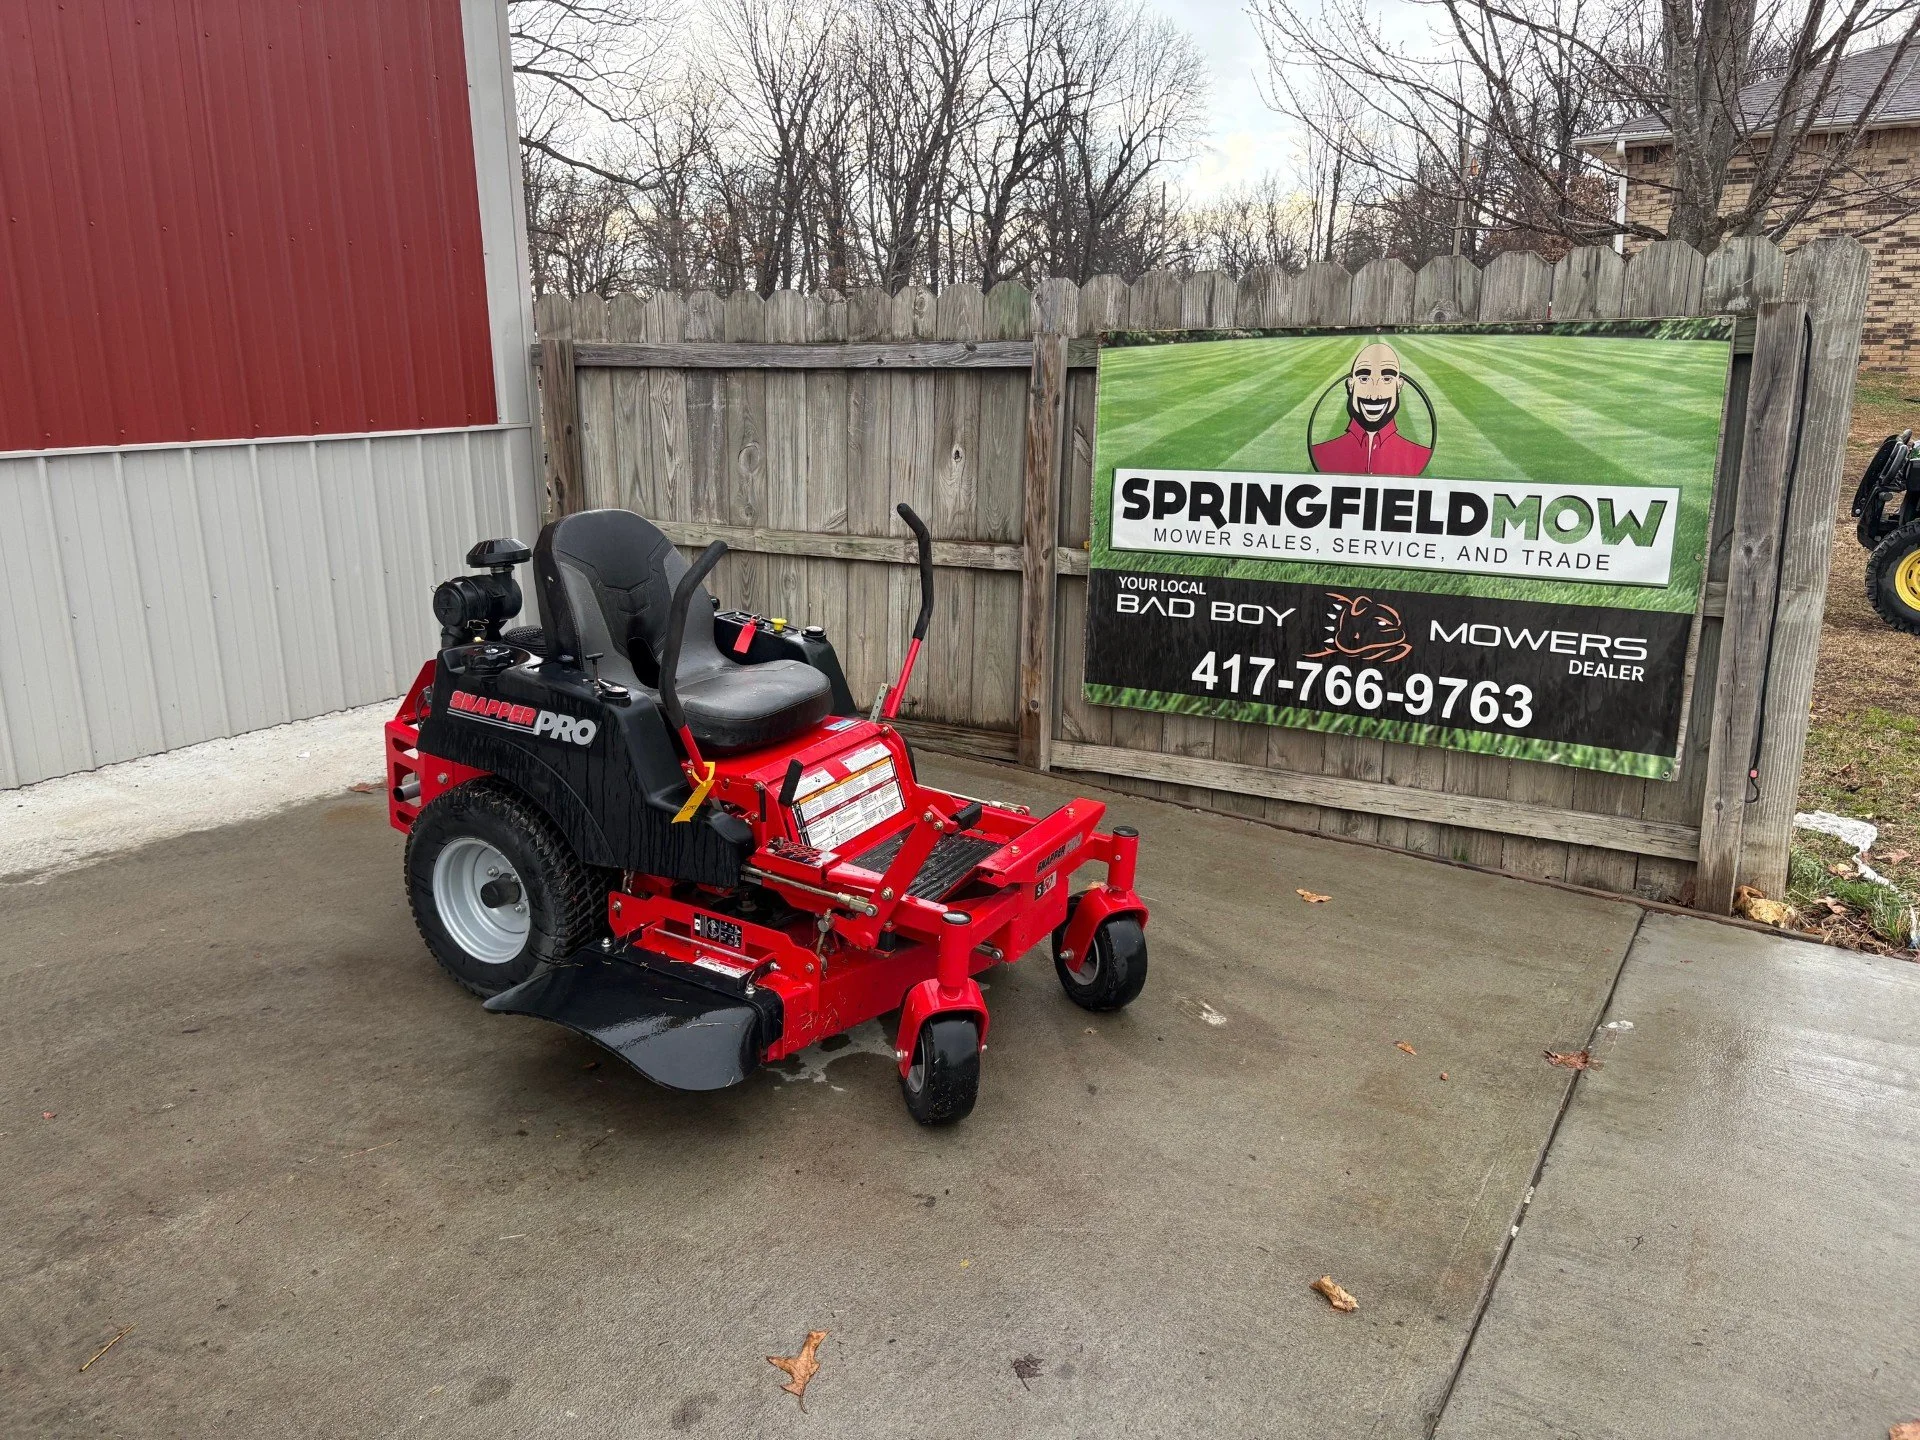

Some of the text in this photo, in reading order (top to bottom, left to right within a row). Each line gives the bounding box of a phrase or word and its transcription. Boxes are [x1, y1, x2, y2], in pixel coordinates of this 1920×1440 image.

[1122, 477, 1668, 548] SPRINGFIELDMOW
[1153, 527, 1610, 571] MOWER SALES, SERVICE, AND TRADE
[1118, 576, 1207, 596] YOUR LOCAL
[1116, 593, 1648, 661] BAD BOY MOWERS
[1191, 650, 1533, 729] 417-766-9763
[1568, 659, 1645, 682] DEALER
[449, 690, 597, 746] SNAPPER PRO
